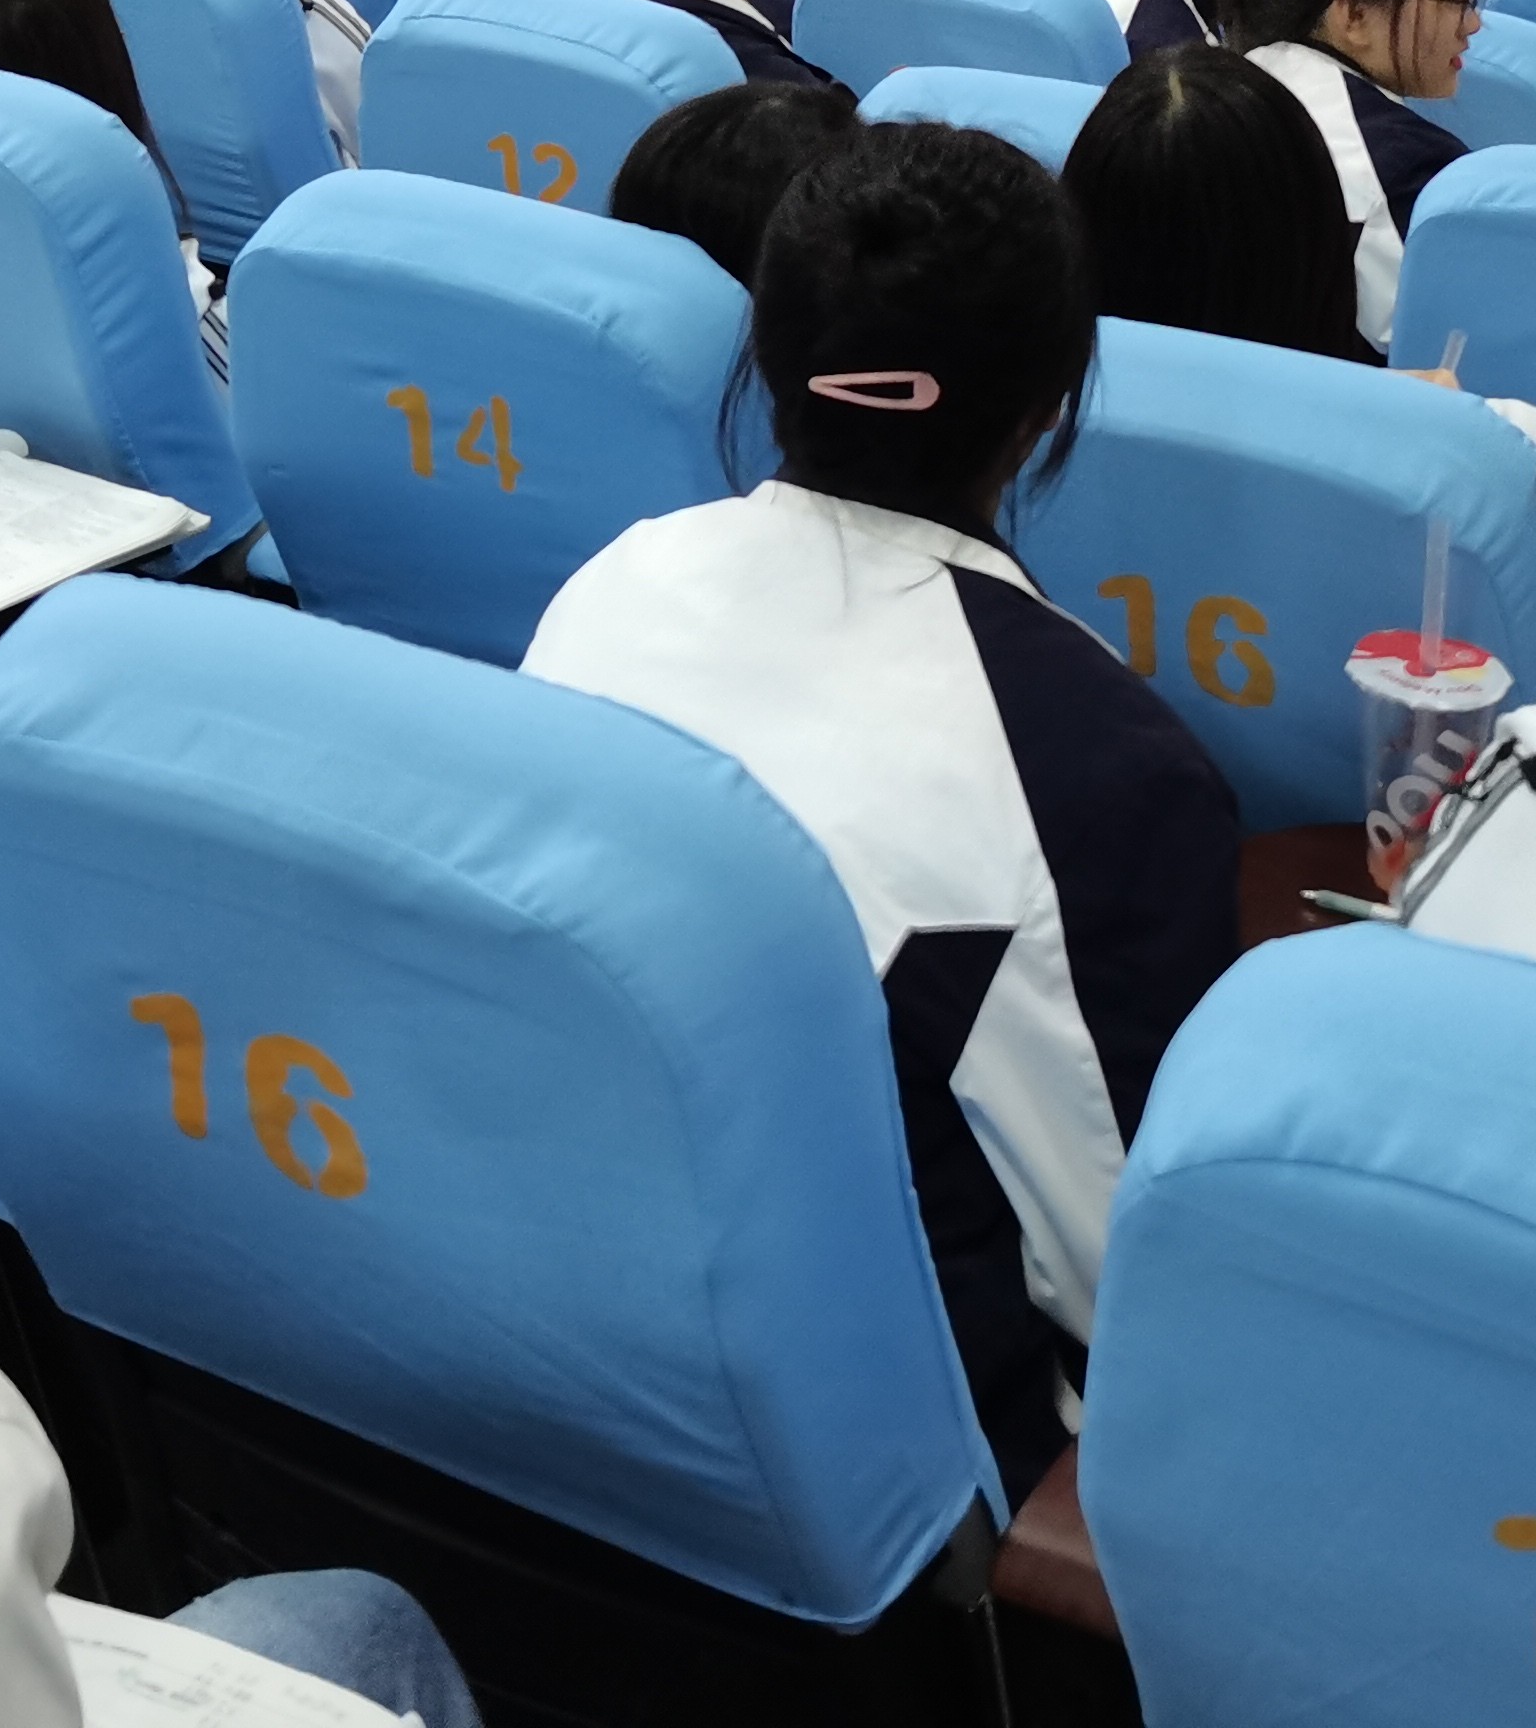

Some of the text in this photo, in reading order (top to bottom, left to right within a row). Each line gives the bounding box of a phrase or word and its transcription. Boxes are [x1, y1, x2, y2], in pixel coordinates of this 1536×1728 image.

[487, 133, 578, 204] 12
[386, 384, 523, 492] 14
[1097, 574, 1276, 708] 16
[129, 992, 369, 1199] 16
